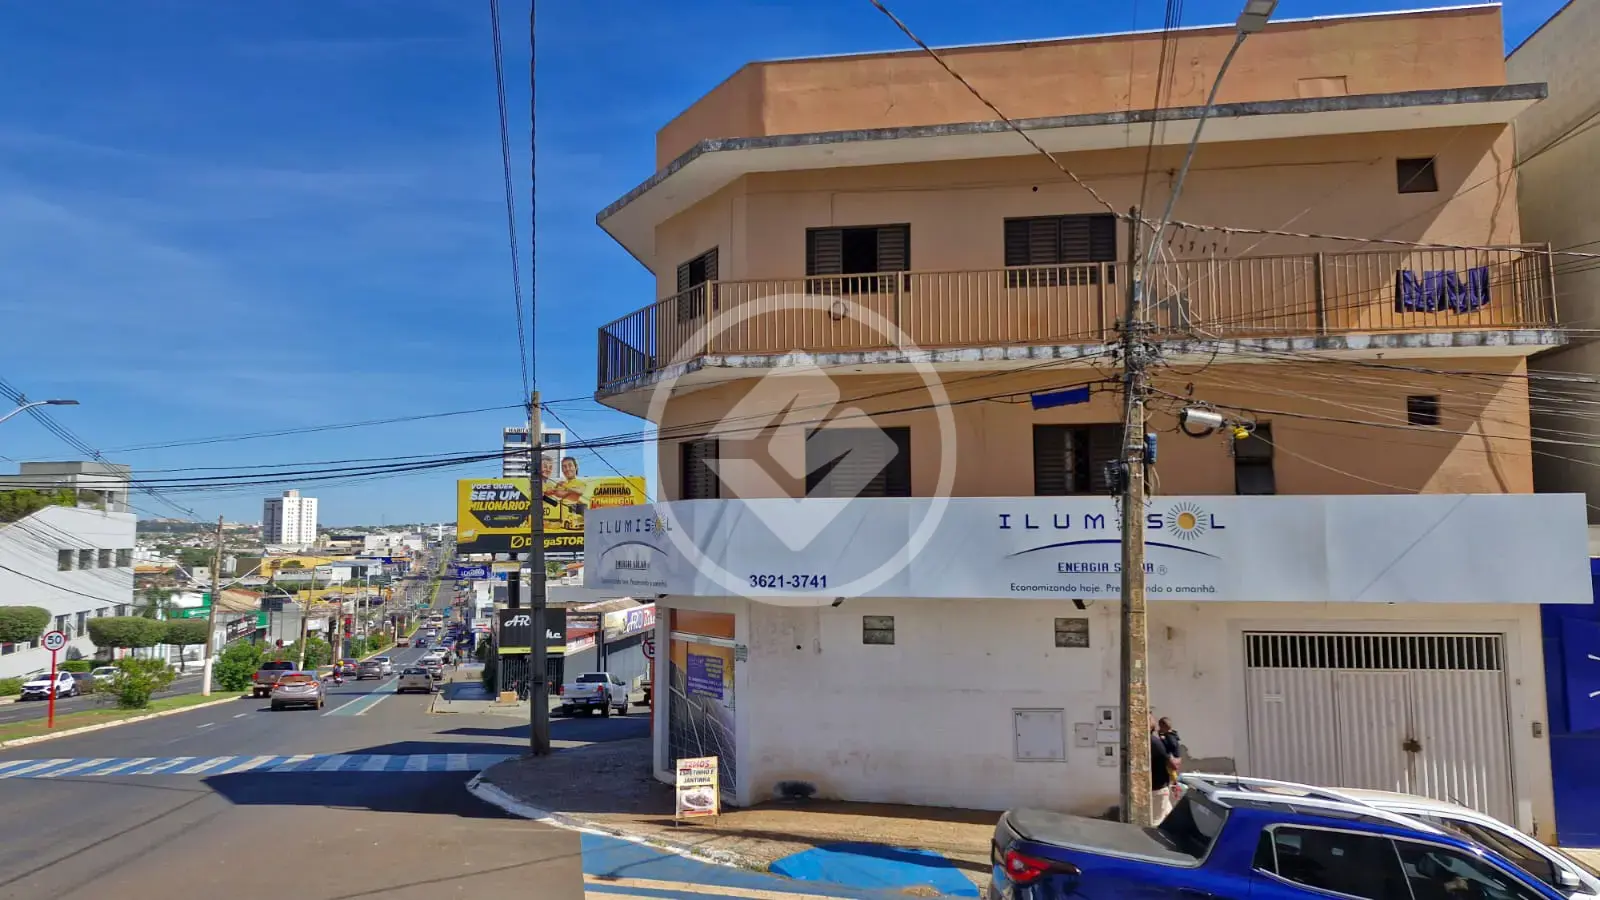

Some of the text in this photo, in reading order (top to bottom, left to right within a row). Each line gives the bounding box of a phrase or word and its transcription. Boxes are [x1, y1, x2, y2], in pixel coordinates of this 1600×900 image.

[470, 490, 521, 501] SER UM
[468, 500, 531, 511] MILIONÁRIO?
[998, 508, 1226, 535] ILUMSOL
[525, 536, 584, 548] DgaSTOR
[1057, 562, 1109, 573] ENERGIA
[749, 574, 827, 588] 3621-3741
[1010, 583, 1077, 592] Economizando
[1079, 583, 1104, 594] hoje.
[1106, 584, 1163, 593] Prendo
[47, 635, 62, 645] 50
